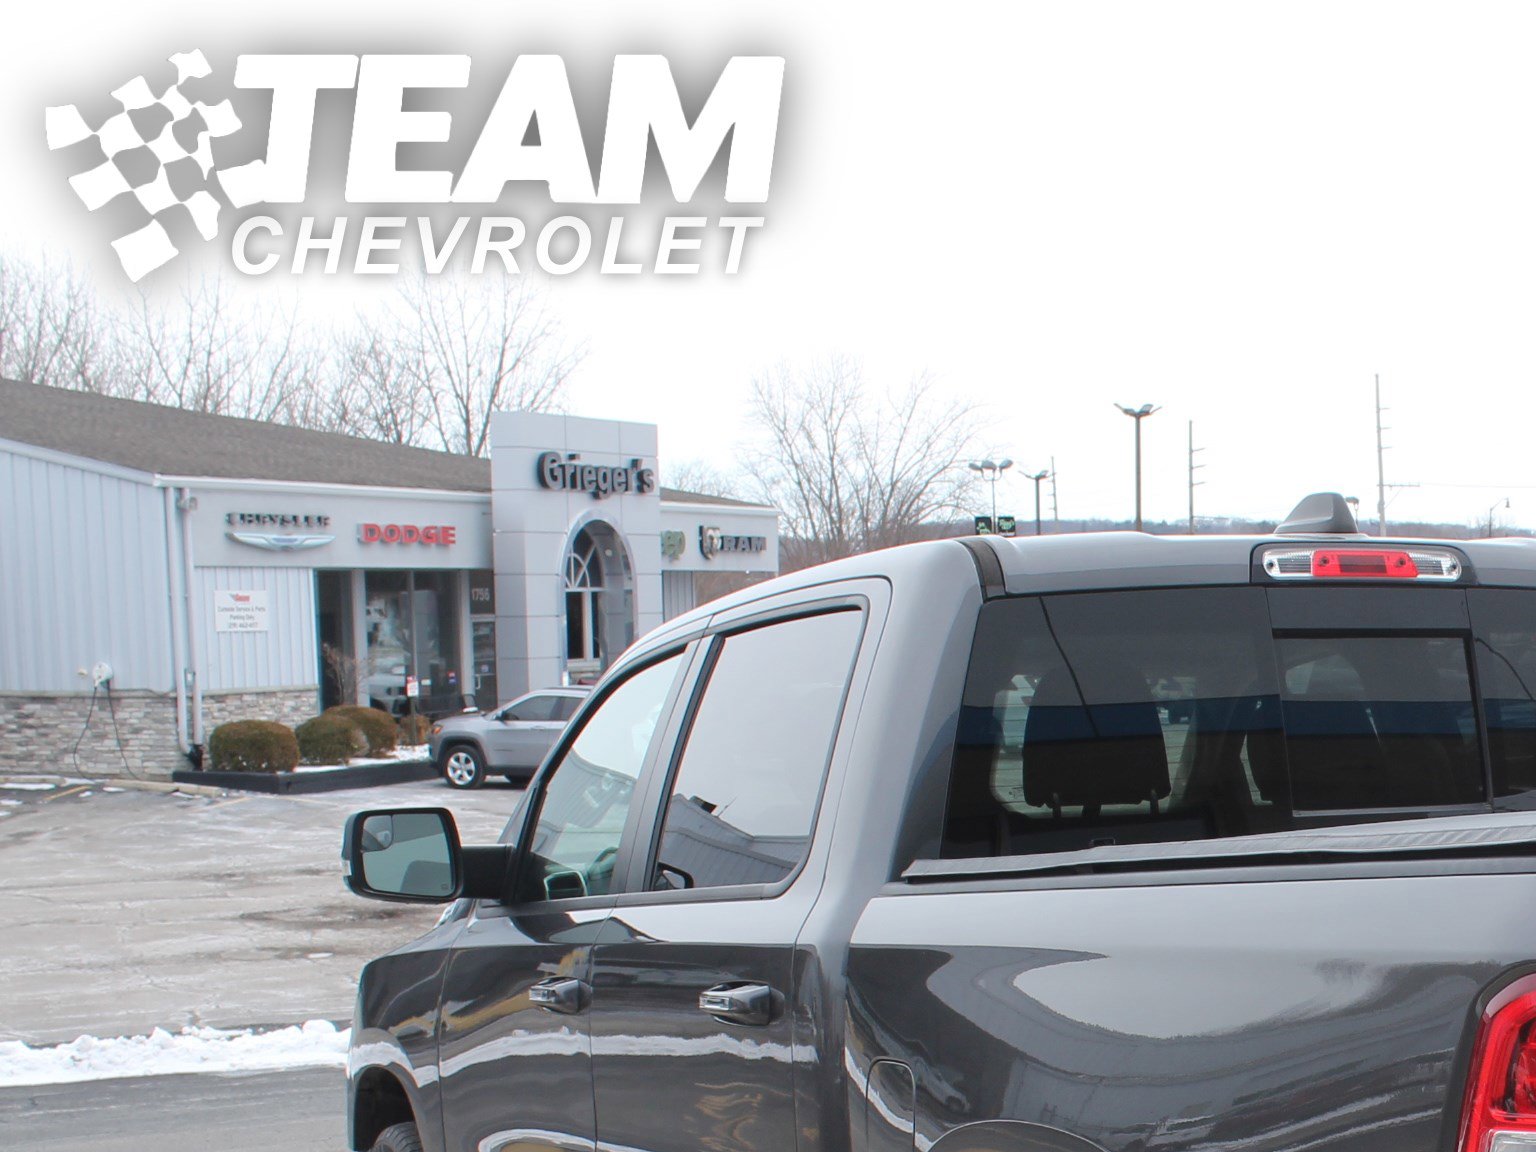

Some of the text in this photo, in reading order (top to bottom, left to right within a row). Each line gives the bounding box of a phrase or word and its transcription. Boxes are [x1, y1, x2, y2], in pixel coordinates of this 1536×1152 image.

[537, 451, 655, 500] Grieger's
[359, 523, 456, 546] DODGE
[720, 535, 767, 553] RAM
